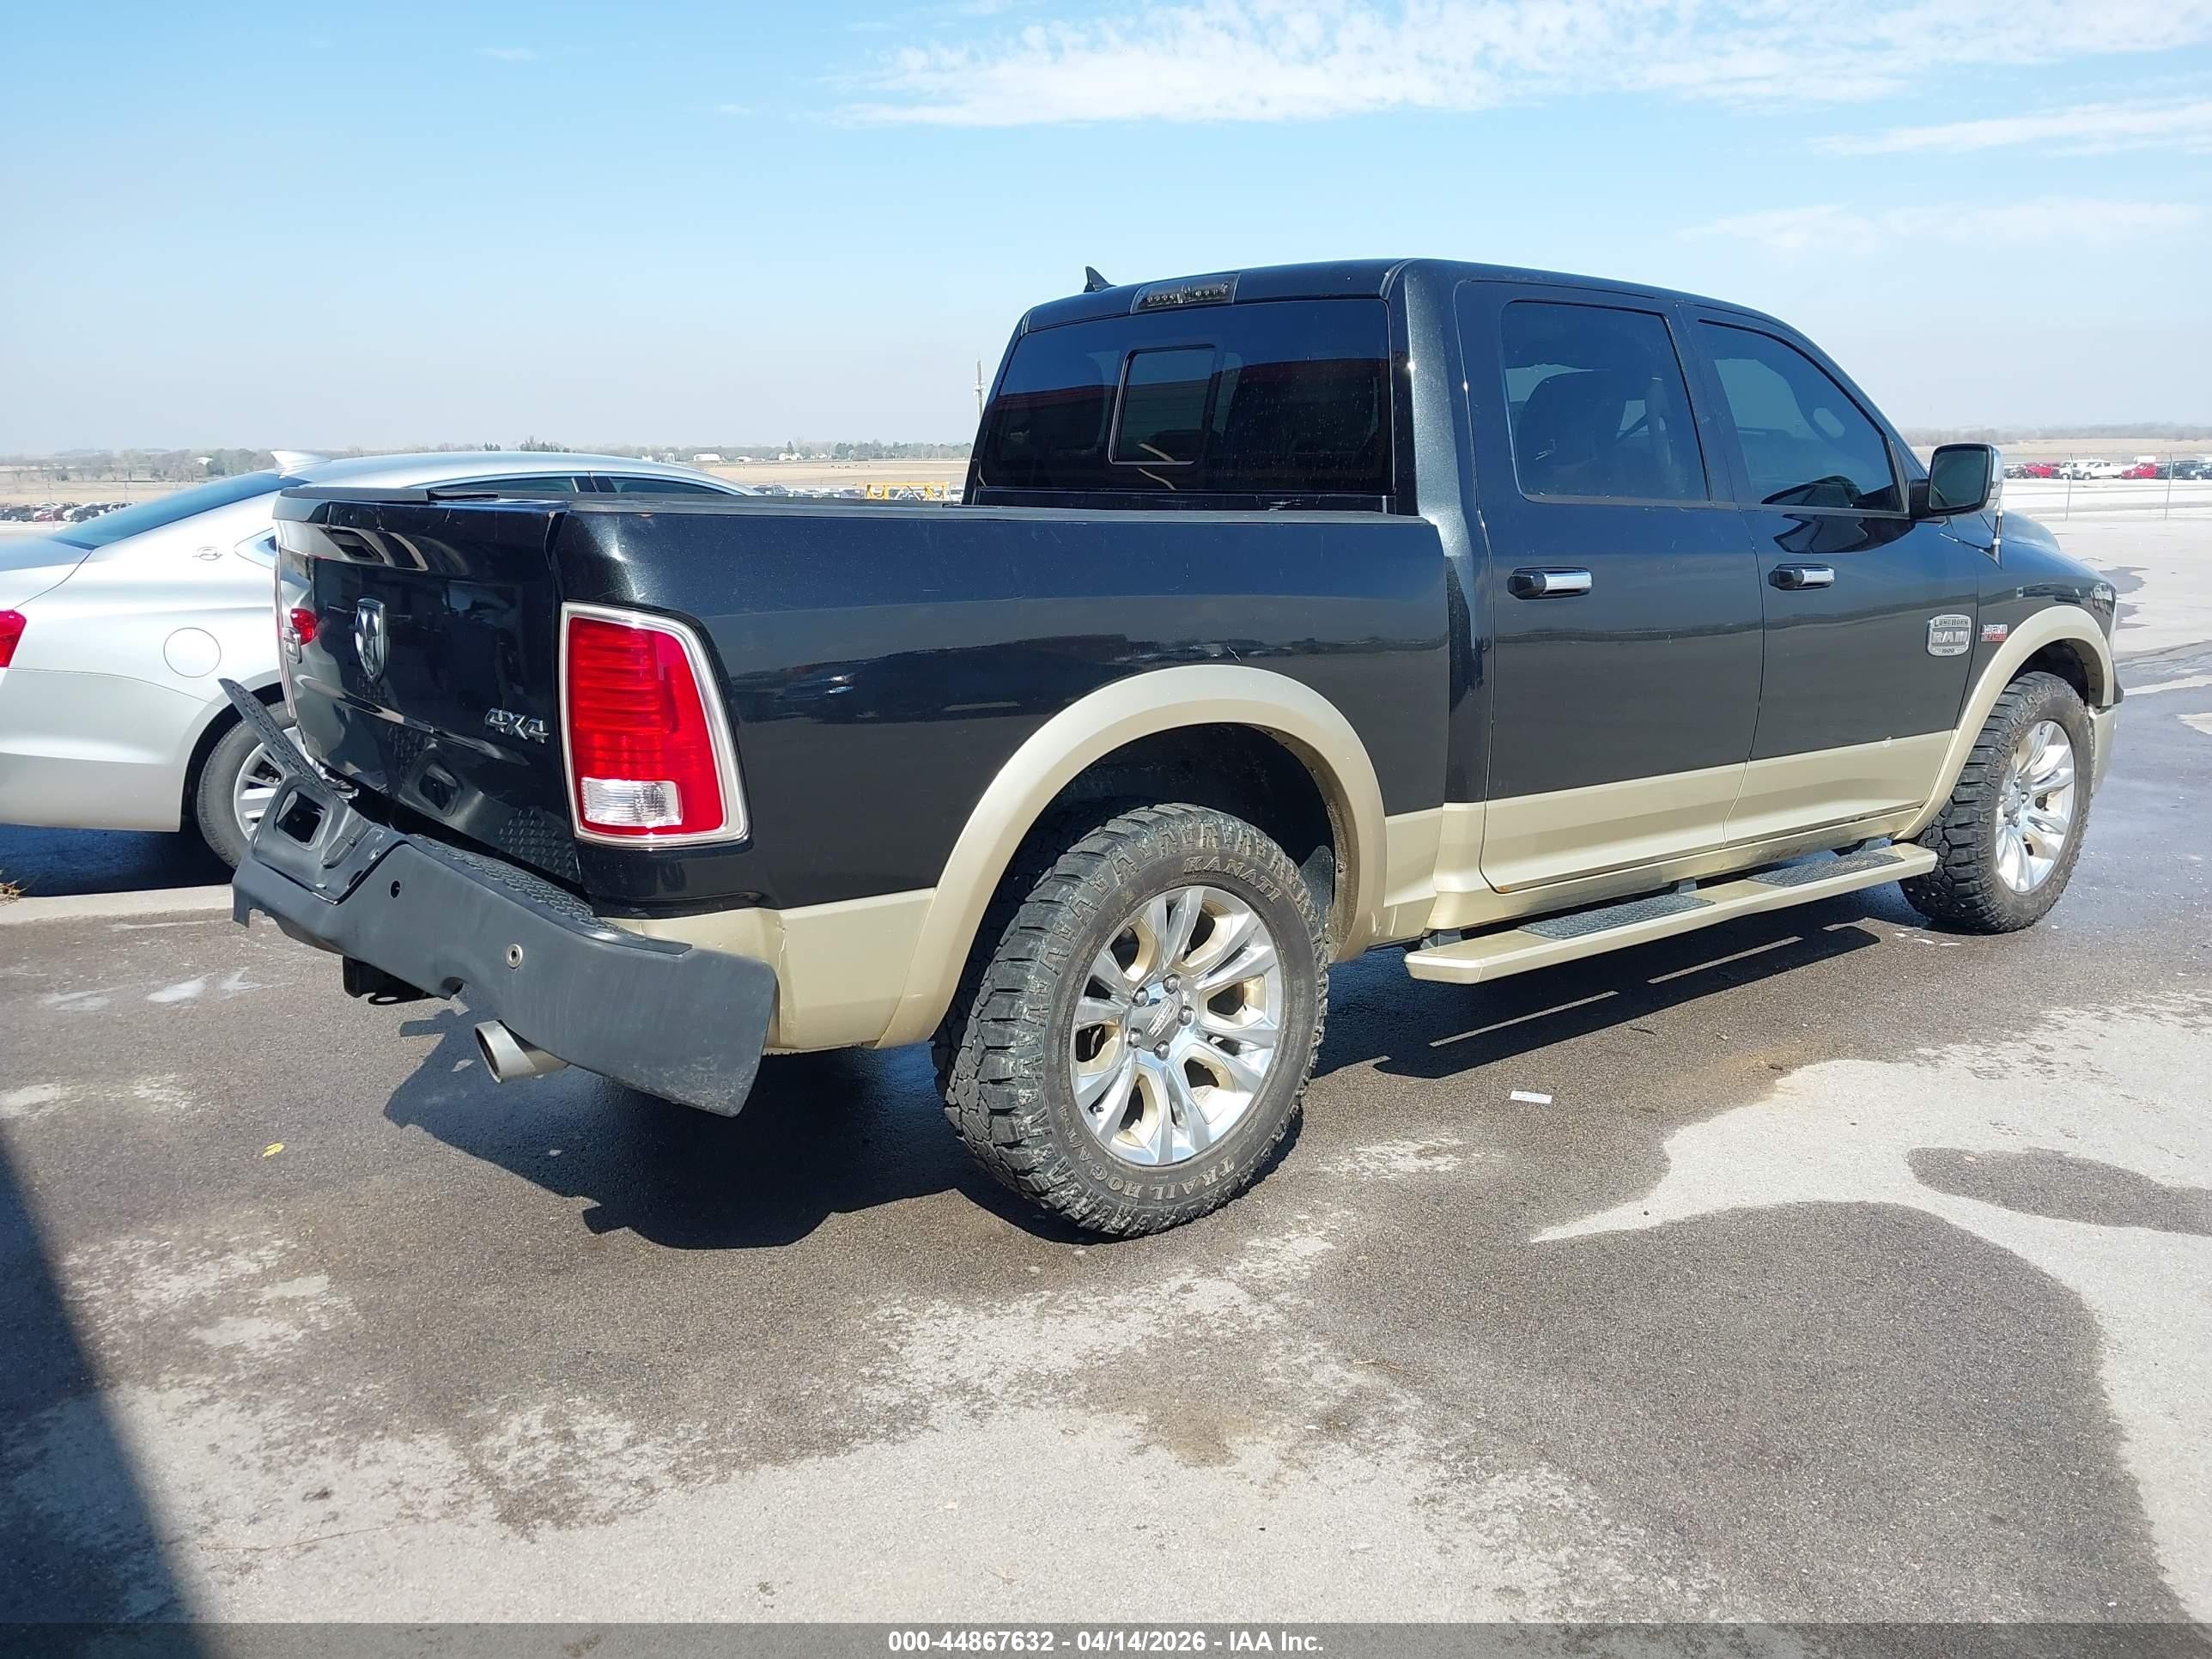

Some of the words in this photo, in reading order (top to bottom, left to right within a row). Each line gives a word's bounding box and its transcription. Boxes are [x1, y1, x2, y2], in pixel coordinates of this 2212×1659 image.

[1932, 630, 1968, 643] RAM
[1183, 856, 1282, 905] KANATI
[1090, 1162, 1145, 1200] HOG
[1149, 1156, 1236, 1201] TRAIL
